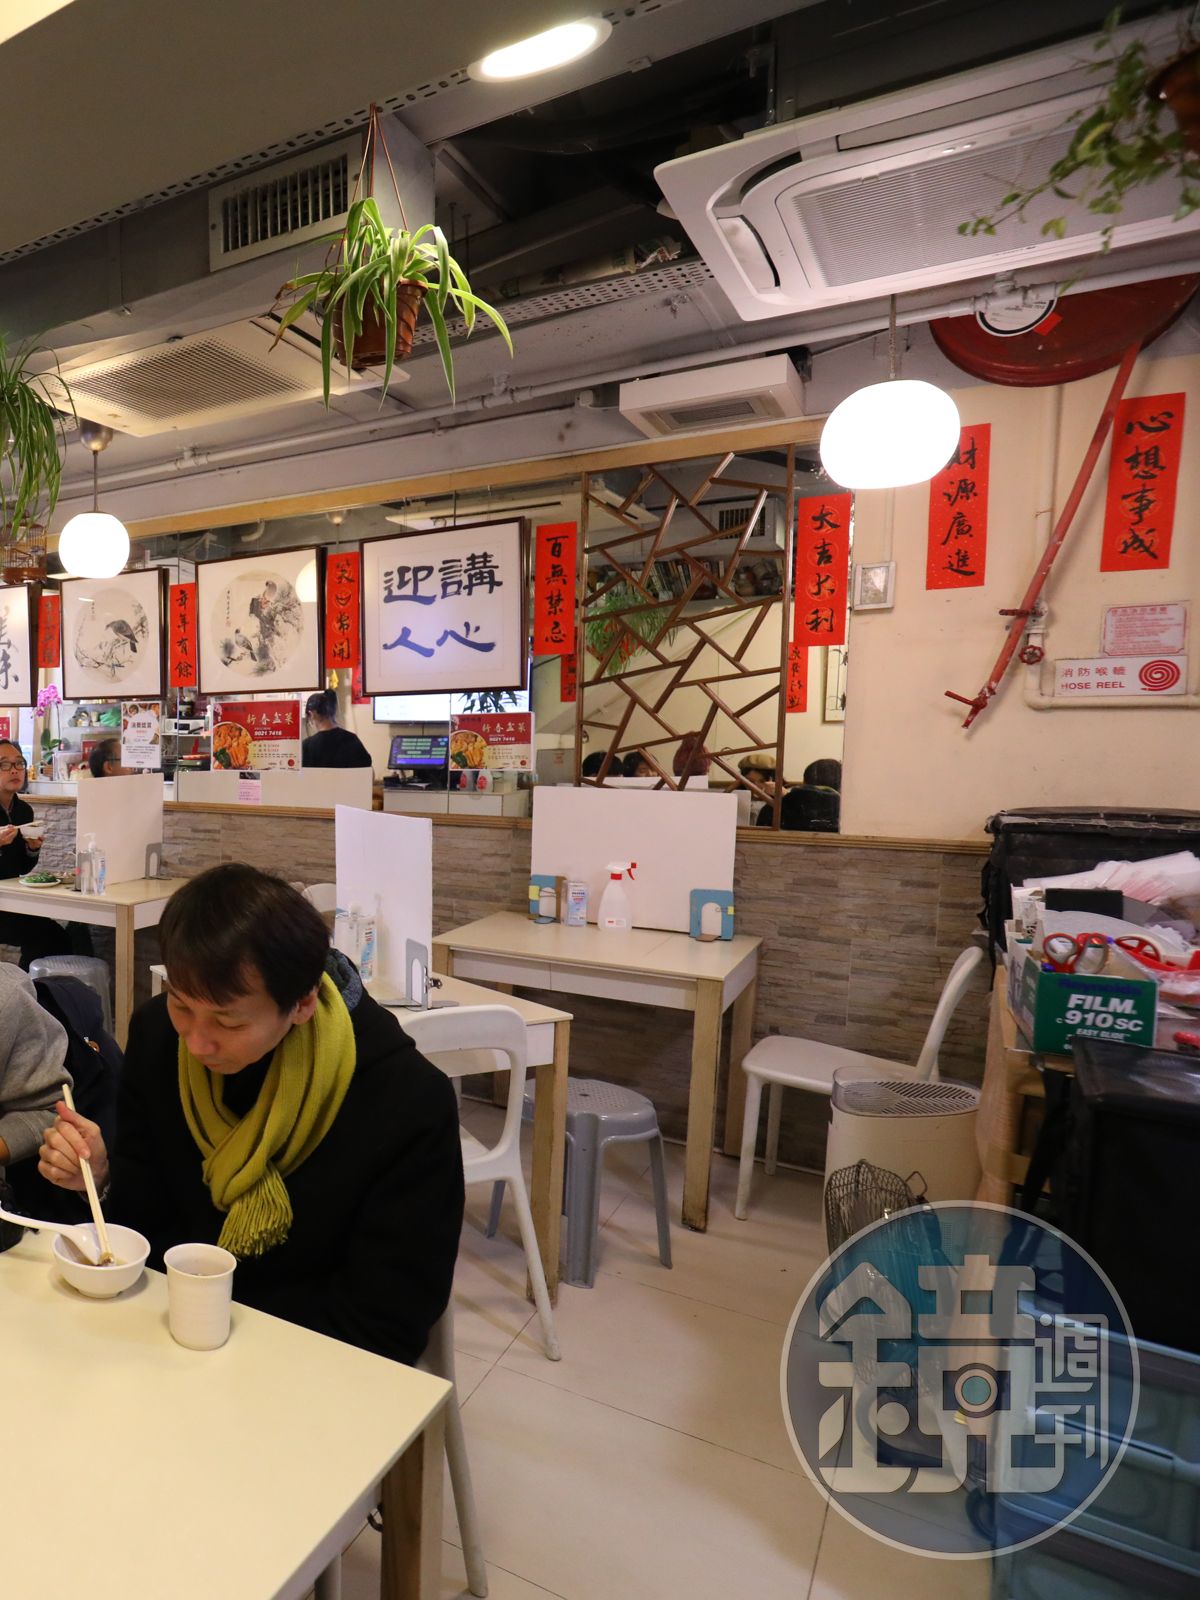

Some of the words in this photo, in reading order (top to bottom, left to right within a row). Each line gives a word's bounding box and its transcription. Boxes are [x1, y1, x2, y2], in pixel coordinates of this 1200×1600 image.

[1118, 409, 1175, 560] 心想事成
[545, 535, 569, 644] 百無禁忌
[805, 504, 841, 634] 大吉大利
[1061, 682, 1091, 690] HOSE
[1096, 681, 1126, 689] REEL
[1067, 994, 1136, 1014] FILM
[1076, 1028, 1100, 1037] EASY
